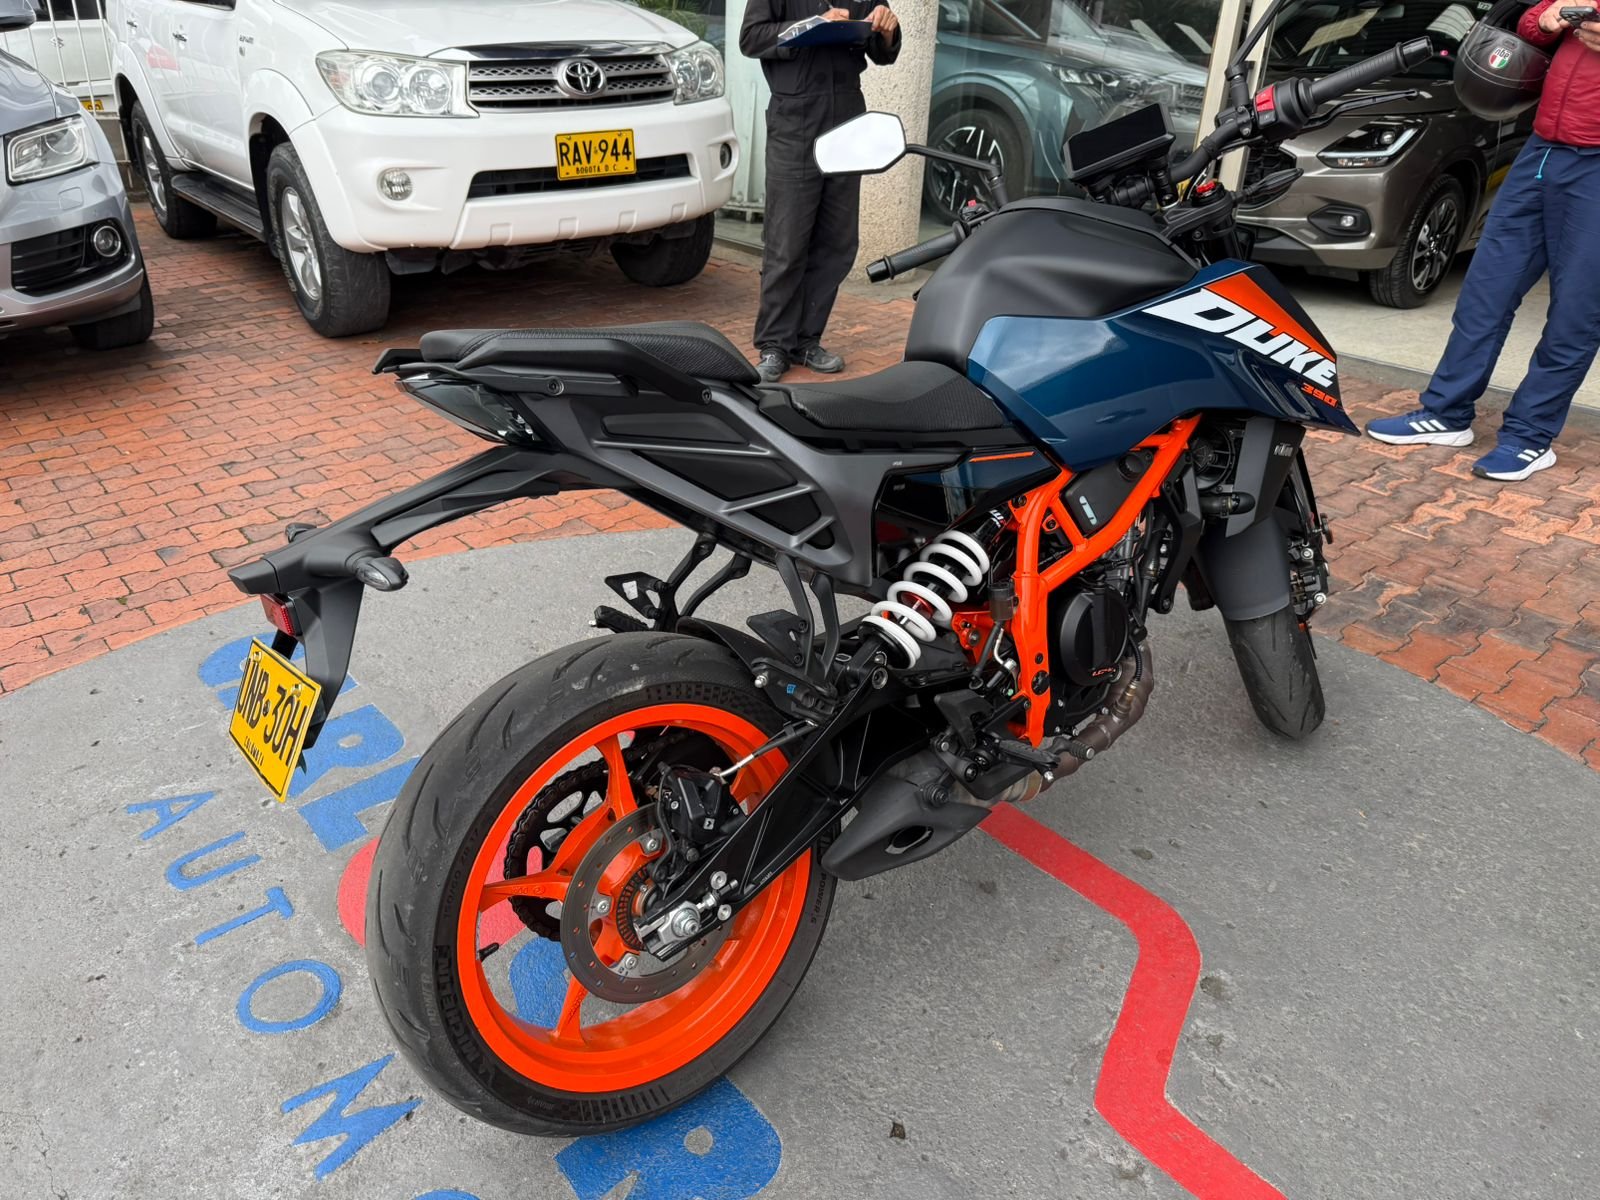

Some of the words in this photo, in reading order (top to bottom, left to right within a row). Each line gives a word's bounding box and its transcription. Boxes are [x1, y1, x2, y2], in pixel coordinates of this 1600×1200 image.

[558, 139, 593, 167] RAV
[598, 136, 632, 164] 944
[1141, 287, 1337, 388] DUKE
[1301, 383, 1338, 408] 390
[263, 684, 308, 767] 30H
[436, 957, 481, 1063] MICHELIN
